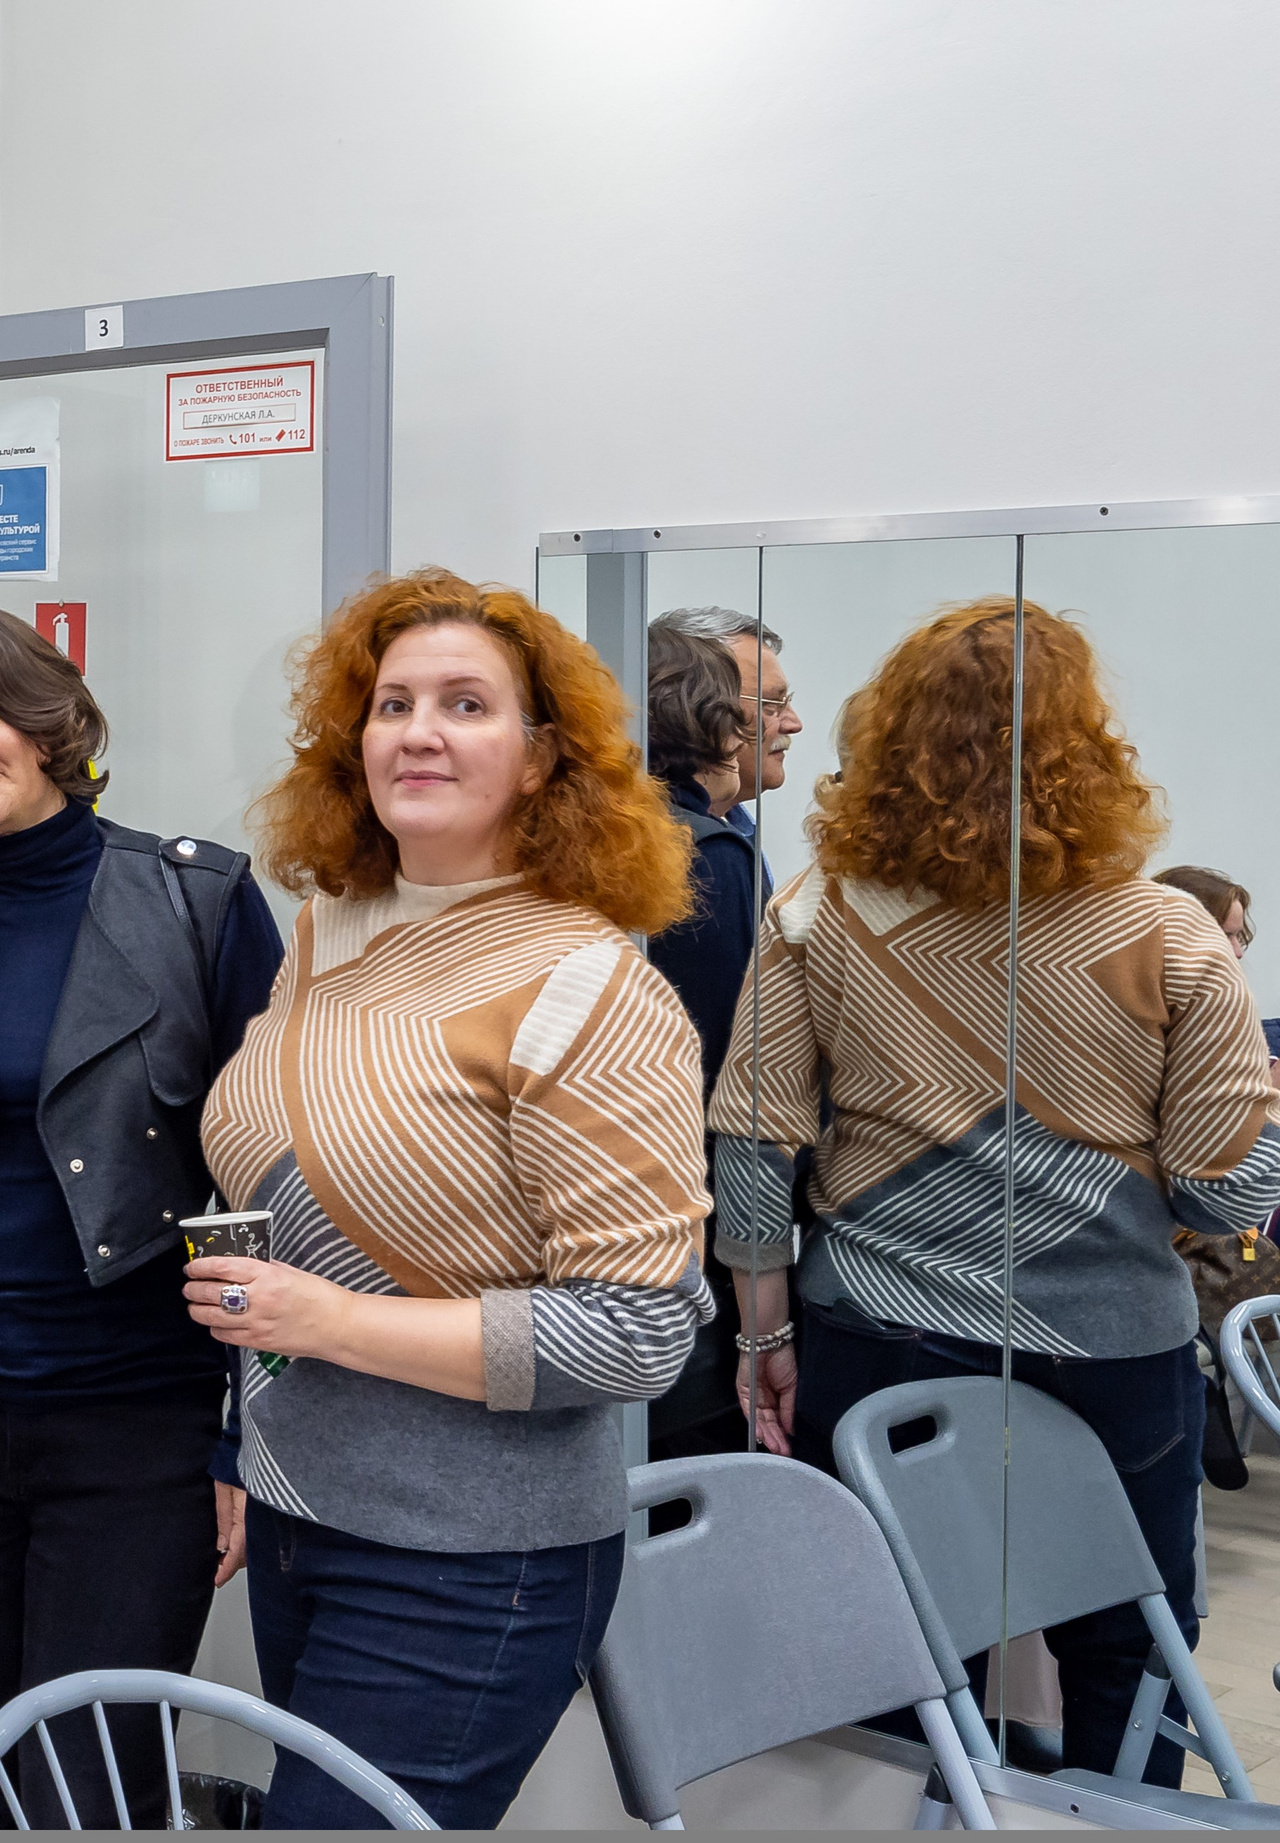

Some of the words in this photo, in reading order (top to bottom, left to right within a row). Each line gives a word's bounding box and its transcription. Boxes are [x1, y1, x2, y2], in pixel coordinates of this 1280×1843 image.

[99, 319, 109, 337] 3
[195, 375, 284, 394] ОТВЕТСТВЕННЫЙ
[178, 398, 188, 406] ЗА
[190, 395, 236, 405] ПОЖАРНУЮ
[237, 389, 302, 402] БЕЗОПАСНОСТЬ
[201, 412, 256, 425] ДЕРКУНСКАЯ
[258, 409, 275, 419] Л.А.
[179, 438, 200, 447] ПОЖАРЕ
[201, 437, 224, 445] ЗВОНИТЬ
[239, 432, 256, 443] 101
[288, 429, 306, 440] 112
